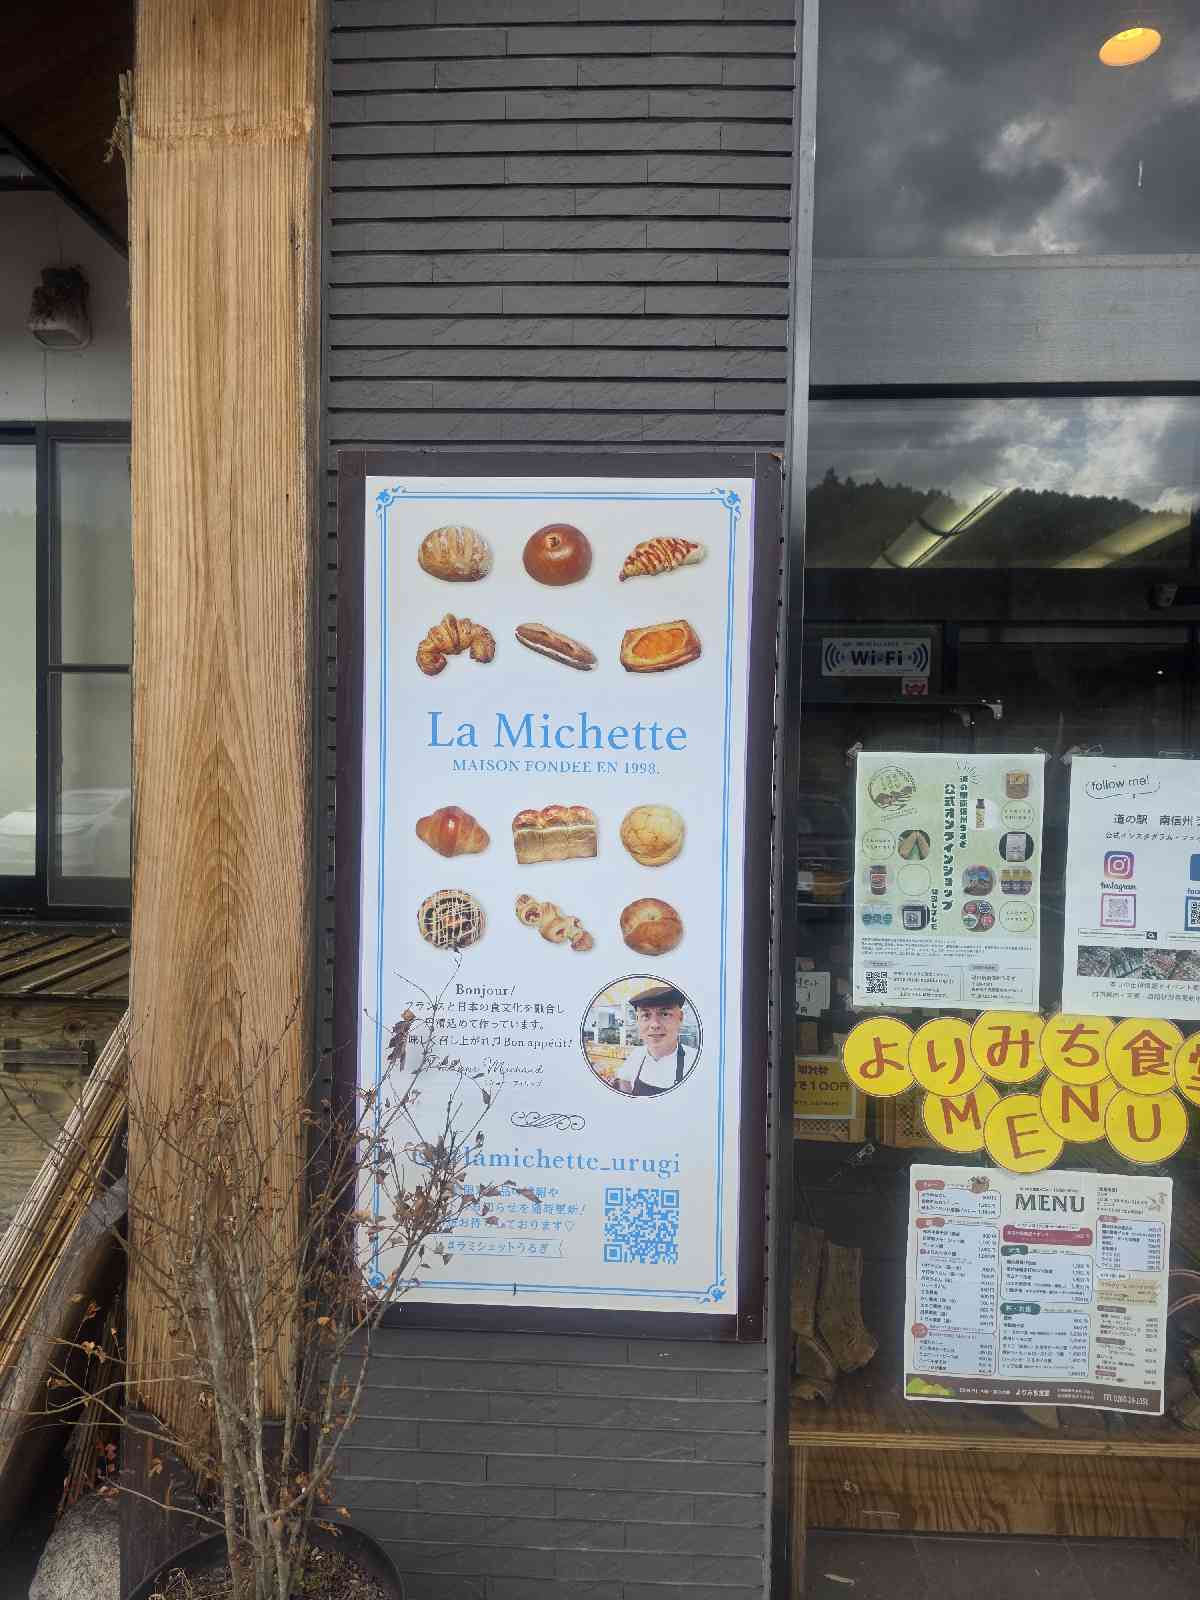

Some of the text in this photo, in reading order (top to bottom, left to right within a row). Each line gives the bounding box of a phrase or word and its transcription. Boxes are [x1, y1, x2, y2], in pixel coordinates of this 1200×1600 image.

[427, 711, 688, 751] La Michette
[452, 759, 520, 772] MAISON
[597, 761, 618, 774] EN
[1092, 775, 1150, 792] follow me!
[1113, 814, 1148, 825] 道の駅
[455, 983, 516, 998] Bonjour!
[940, 1085, 1162, 1159] MENU
[1015, 1193, 1085, 1213] MENU
